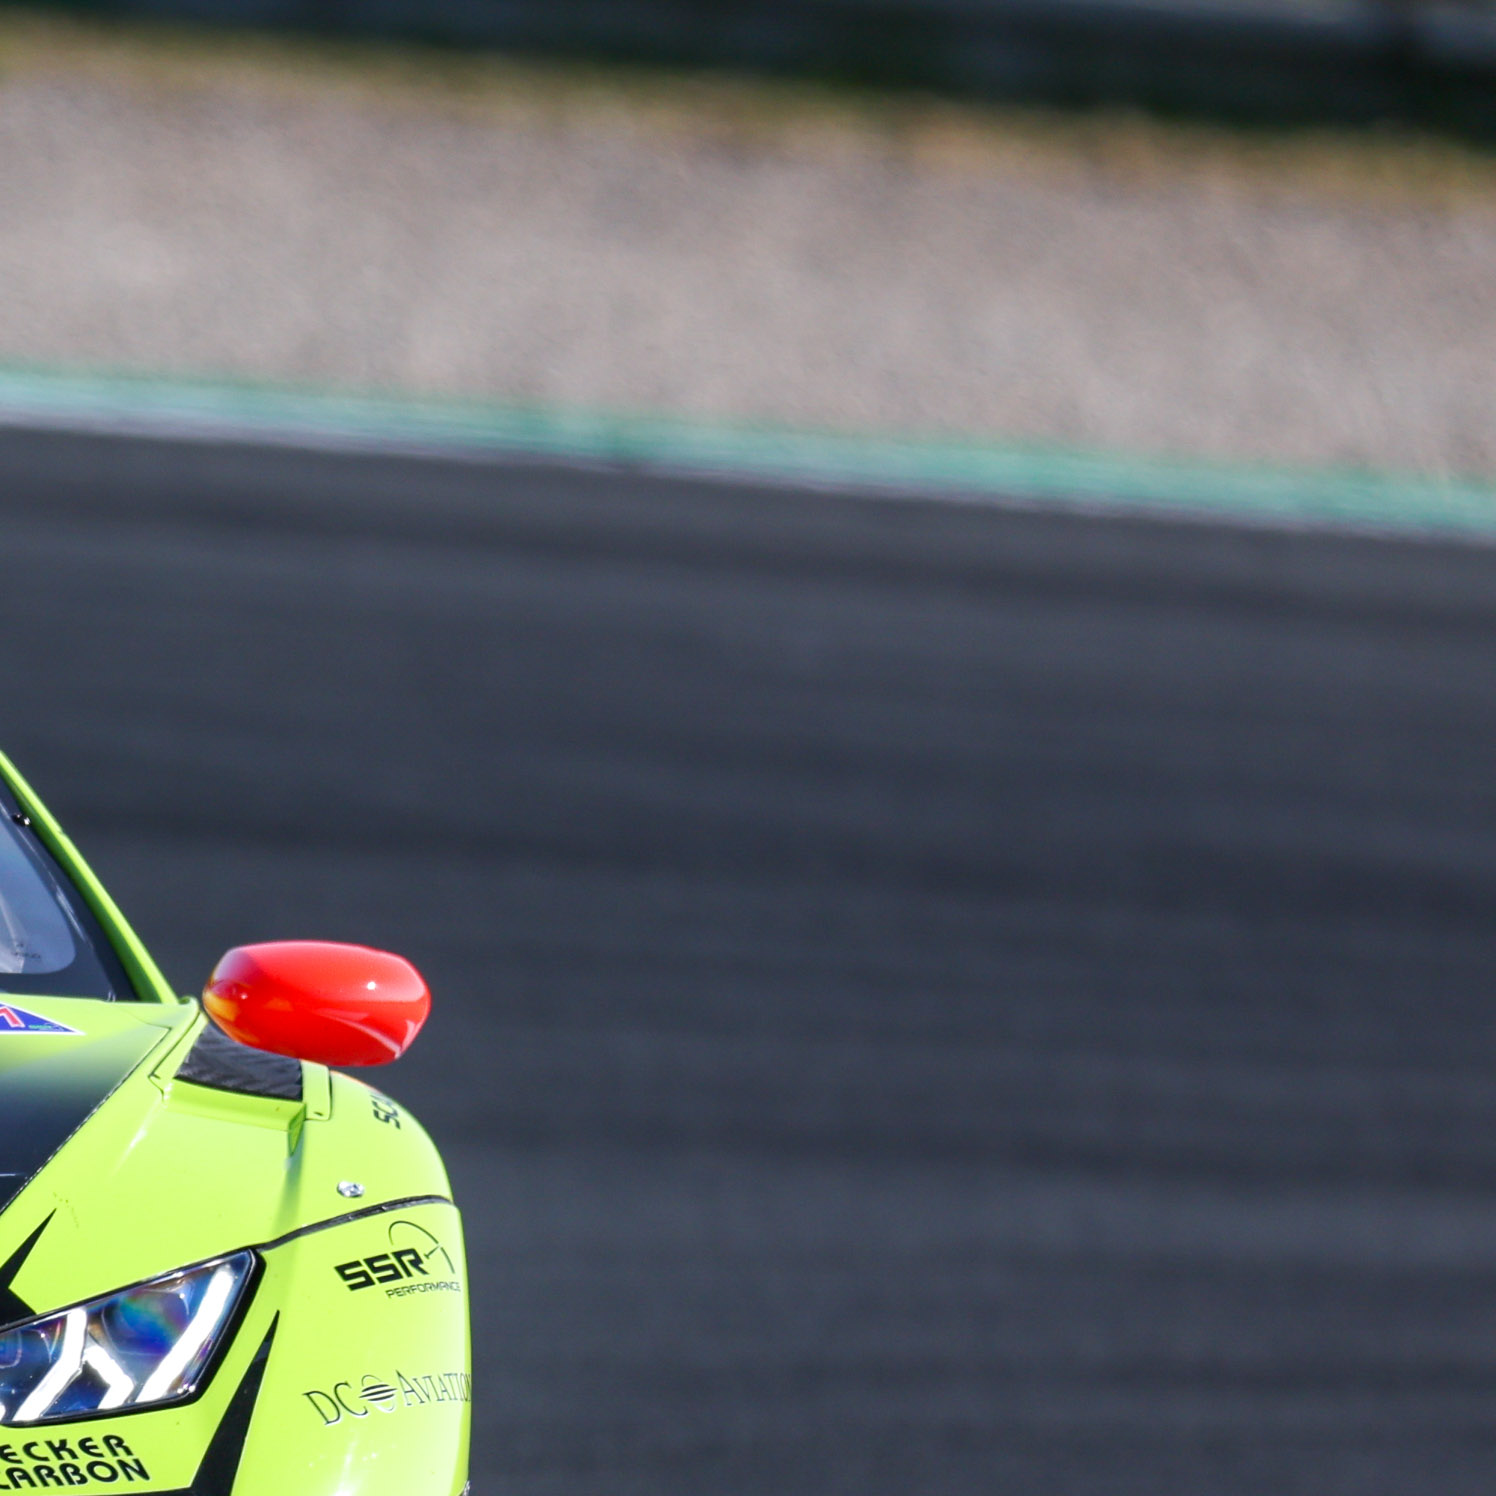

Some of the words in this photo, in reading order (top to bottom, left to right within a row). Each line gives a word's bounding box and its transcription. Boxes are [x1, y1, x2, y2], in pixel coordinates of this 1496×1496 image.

[333, 1247, 430, 1292] SSR
[385, 1280, 461, 1299] PERFORMANCE
[302, 1380, 368, 1426] DC
